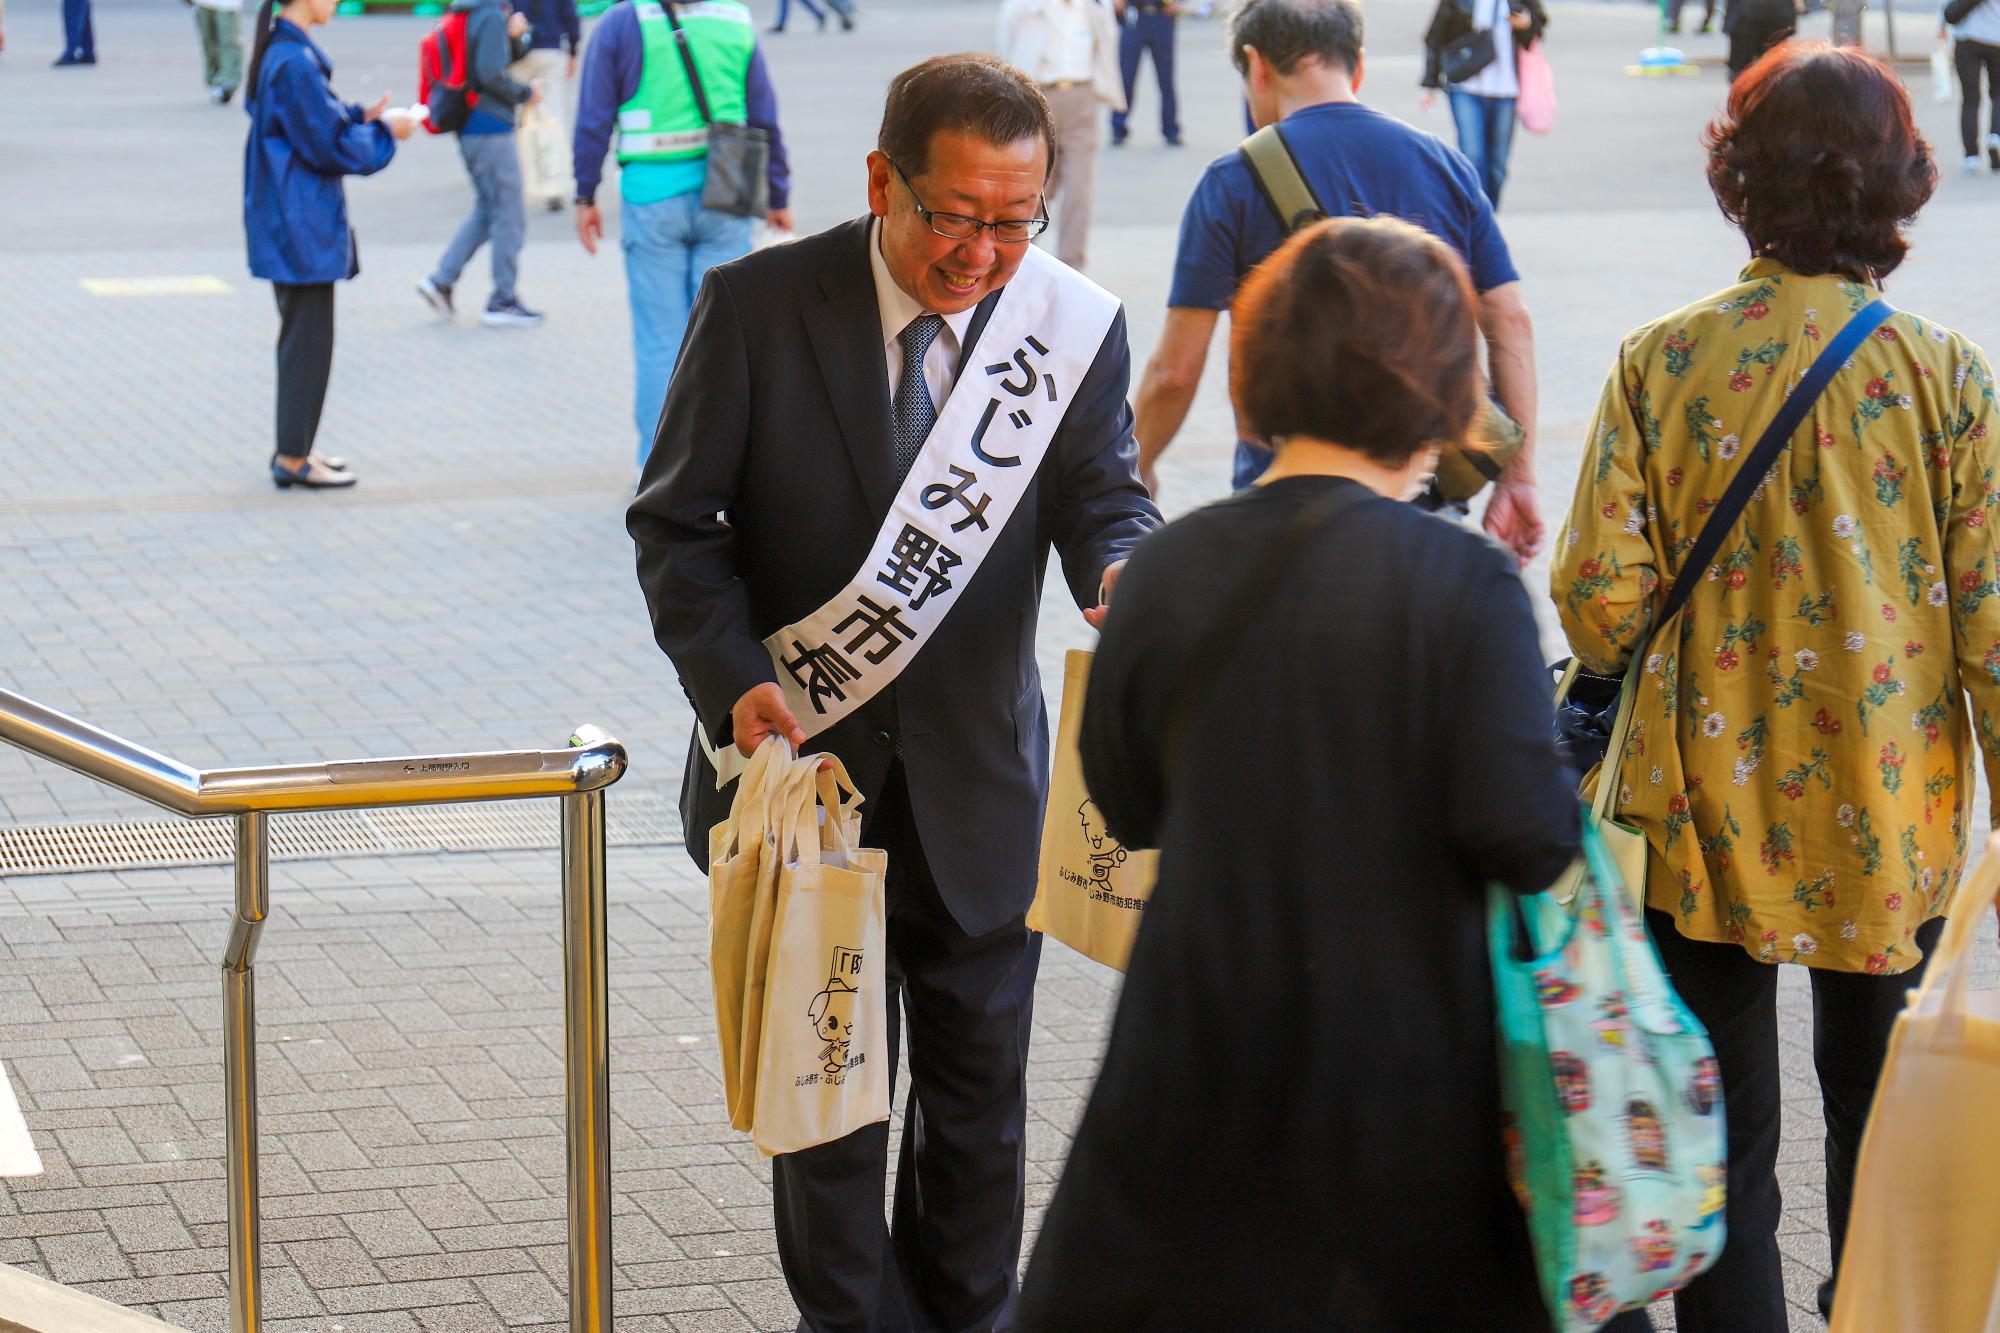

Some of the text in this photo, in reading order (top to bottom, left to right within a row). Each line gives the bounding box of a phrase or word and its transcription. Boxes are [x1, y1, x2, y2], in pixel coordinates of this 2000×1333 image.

[780, 335, 1058, 714] ふじみ野市長
